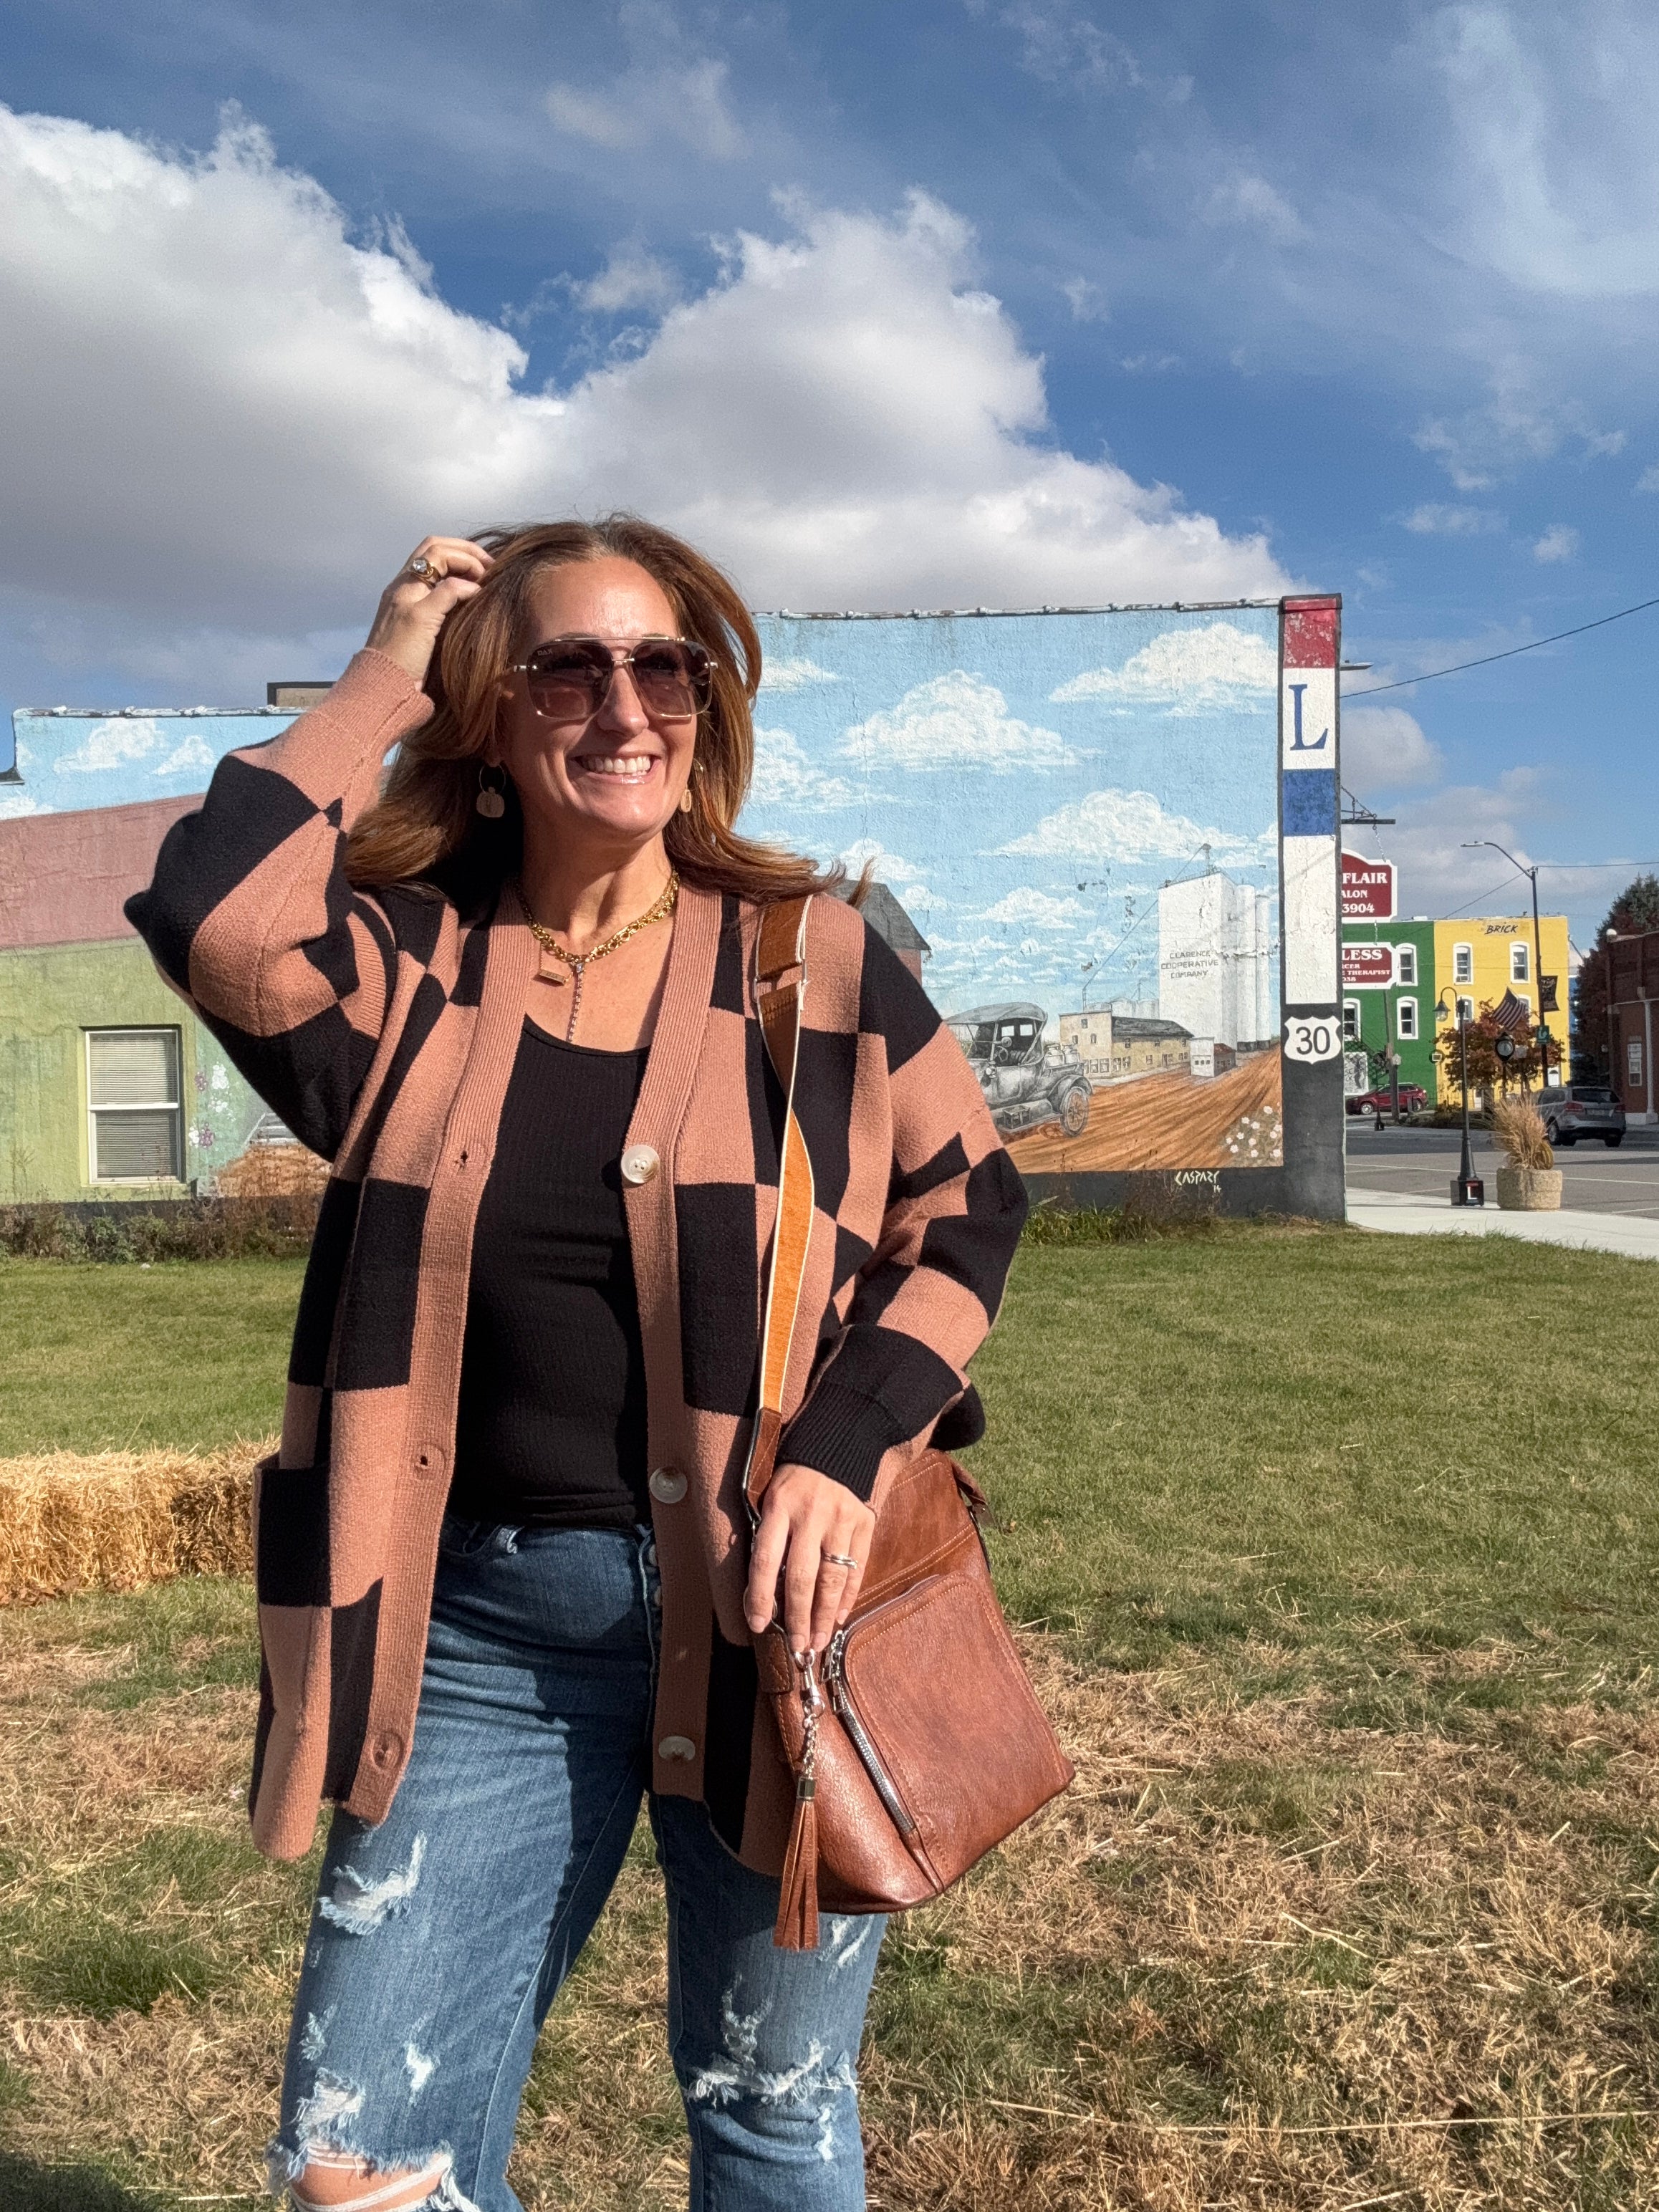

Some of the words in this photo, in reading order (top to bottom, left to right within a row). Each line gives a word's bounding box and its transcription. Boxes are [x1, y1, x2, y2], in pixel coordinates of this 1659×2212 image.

[1288, 683, 1329, 751] L
[1342, 872, 1388, 884] FLAIR
[1342, 903, 1375, 913] 3904
[1484, 924, 1519, 935] BRICK
[1169, 951, 1211, 959] CLARENCE
[1342, 949, 1382, 961] LESS
[1160, 960, 1218, 970] COOPERATIVE
[1170, 970, 1208, 979] COMPANY
[1296, 1026, 1330, 1055] 30
